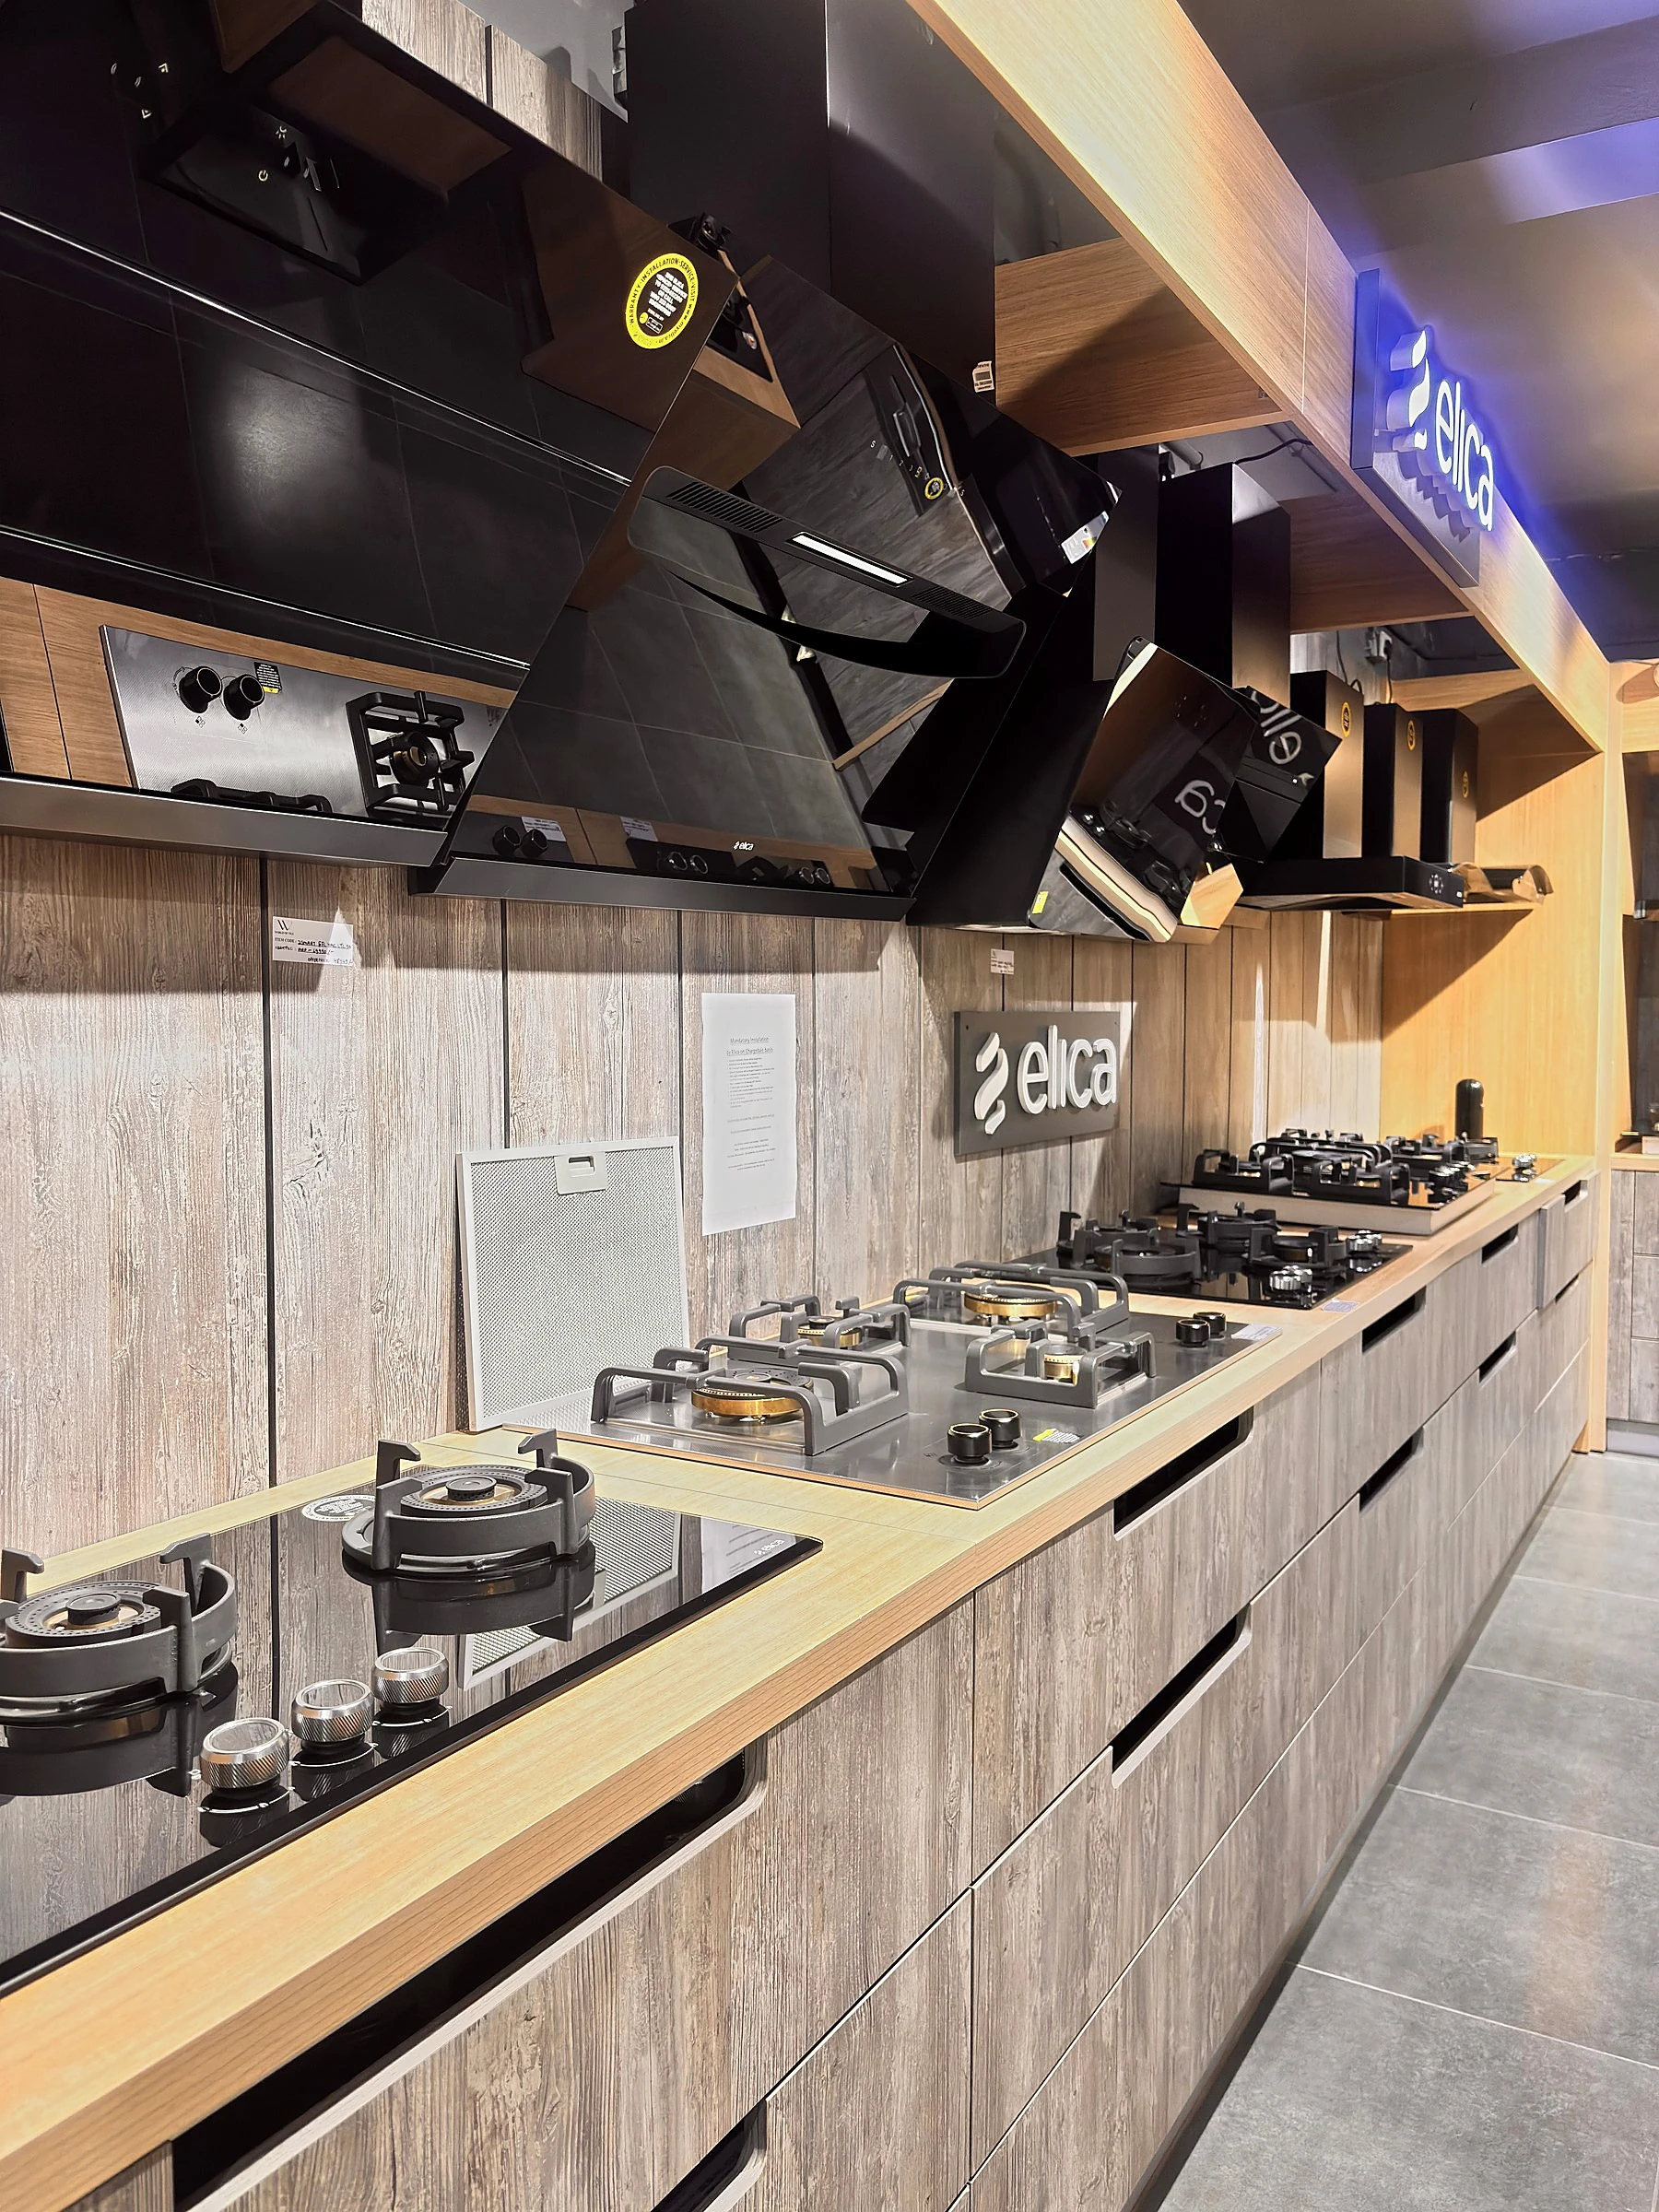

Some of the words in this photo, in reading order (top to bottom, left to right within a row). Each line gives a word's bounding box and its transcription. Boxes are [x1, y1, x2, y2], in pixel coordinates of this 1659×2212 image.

[629, 285, 641, 324] WARRANTY
[641, 258, 679, 282] INSTALLATION
[679, 261, 695, 282] SERVICE
[1435, 380, 1494, 532] elica
[1017, 1024, 1117, 1115] elica
